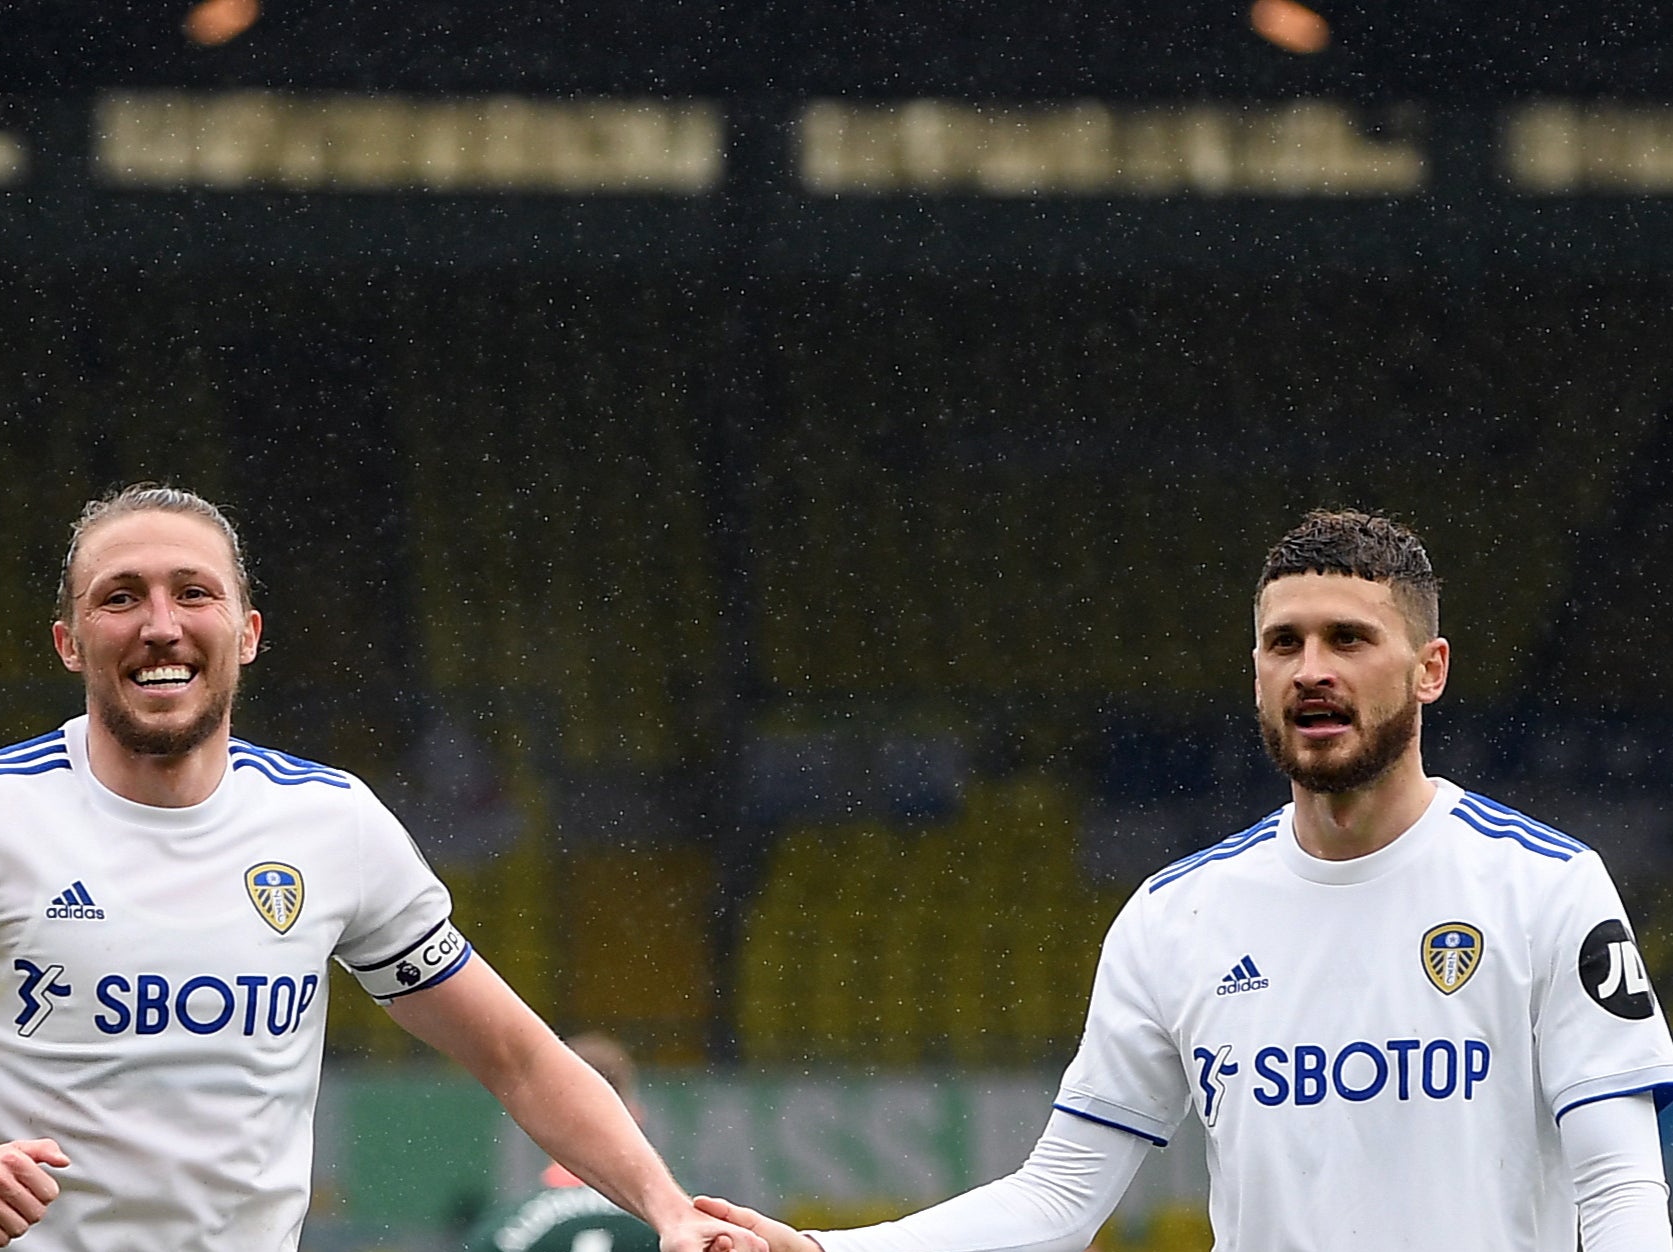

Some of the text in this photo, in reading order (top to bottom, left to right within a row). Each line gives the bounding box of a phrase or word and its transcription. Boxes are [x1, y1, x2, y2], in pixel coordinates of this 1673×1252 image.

[45, 904, 106, 921] adidas
[422, 926, 462, 967] Cap
[93, 974, 319, 1037] SBOTOP
[1215, 976, 1270, 997] adidas
[1253, 1039, 1491, 1107] SBOTOP
